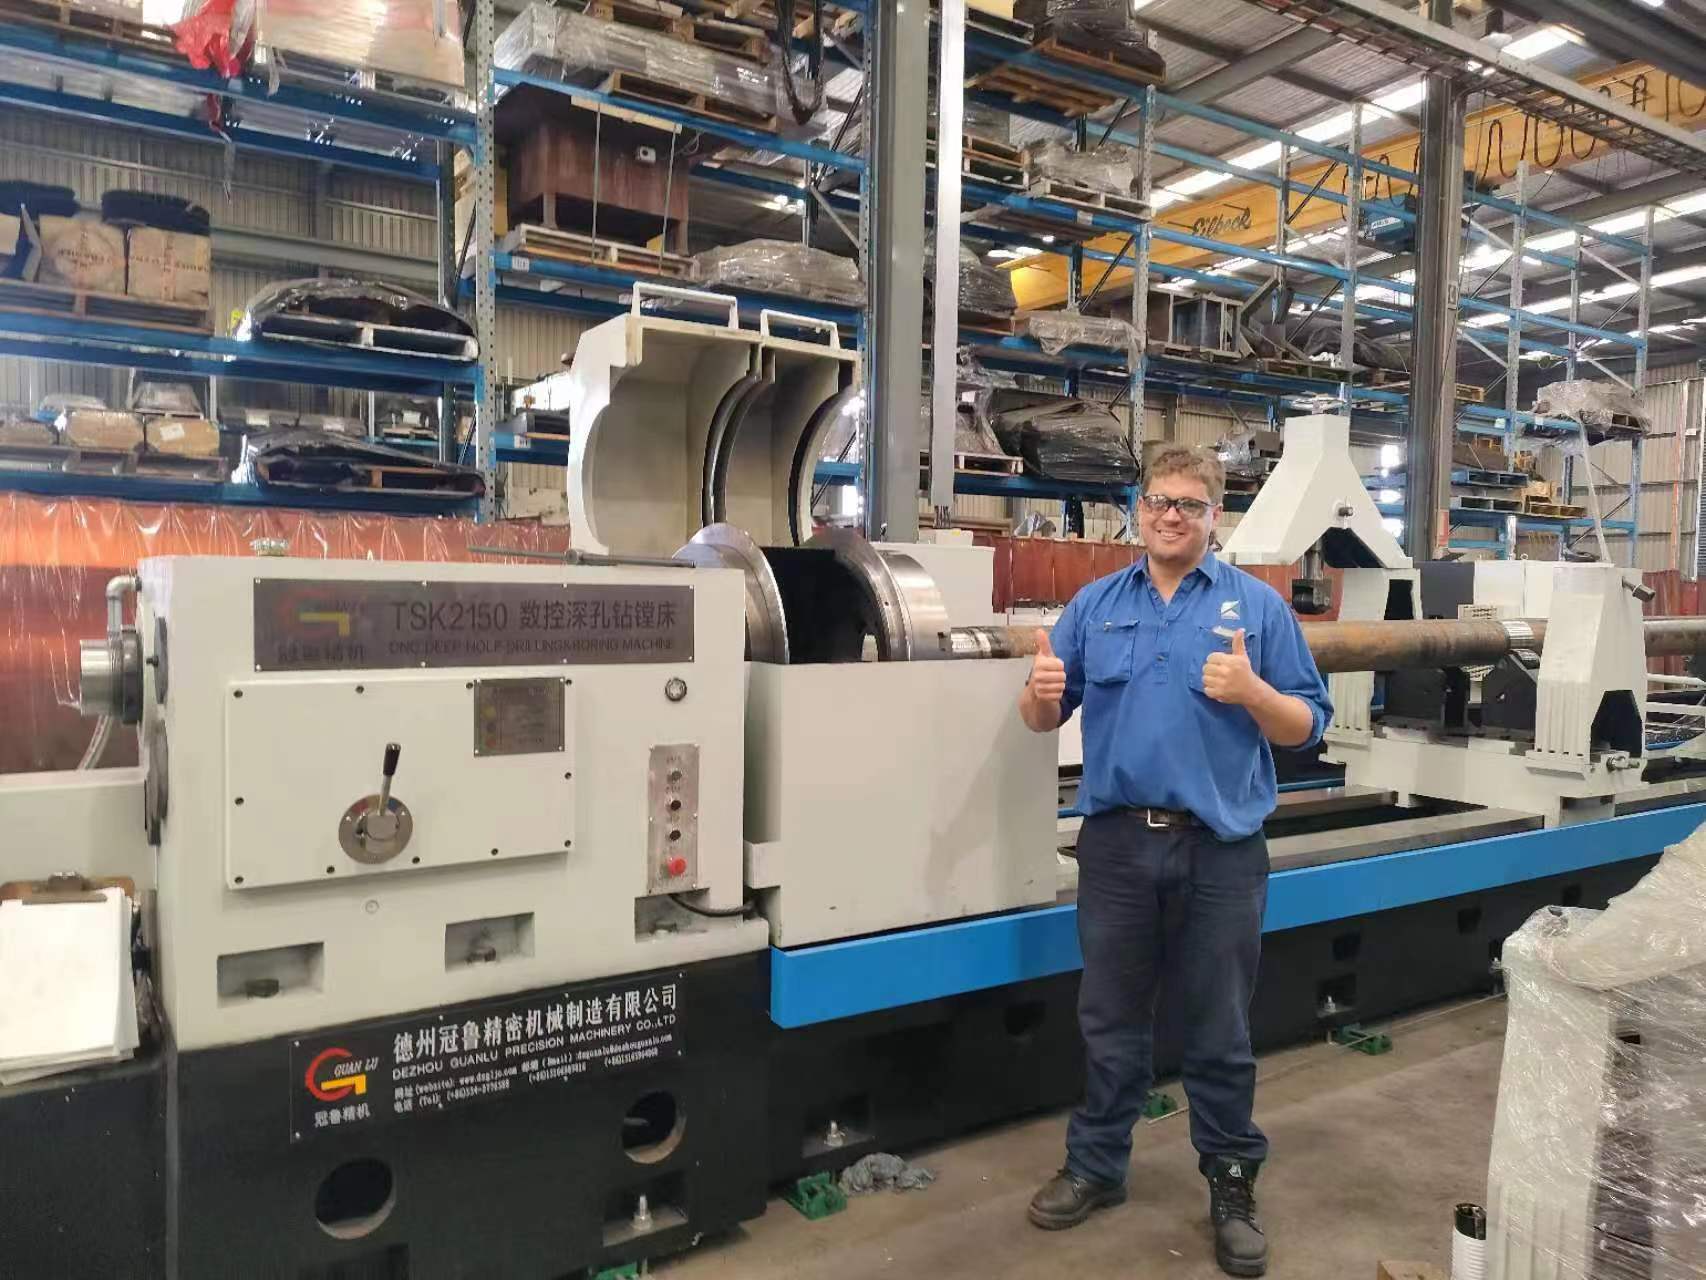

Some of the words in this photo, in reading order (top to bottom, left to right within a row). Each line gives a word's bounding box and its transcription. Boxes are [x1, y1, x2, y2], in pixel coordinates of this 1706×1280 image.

[390, 600, 508, 632] TSK2150
[519, 599, 677, 631] 数控深孔钻镗床
[622, 637, 674, 651] MACHINE
[392, 983, 679, 1063] 德州冠鲁精密机械制造有限公司
[392, 1060, 443, 1081] DEZHOU
[450, 1050, 499, 1069] GUANLU
[505, 1037, 565, 1058] PRECISION
[570, 1023, 632, 1044] MACHINERY
[334, 1059, 362, 1078] GUAN
[313, 1102, 371, 1128] 冠鲁精机
